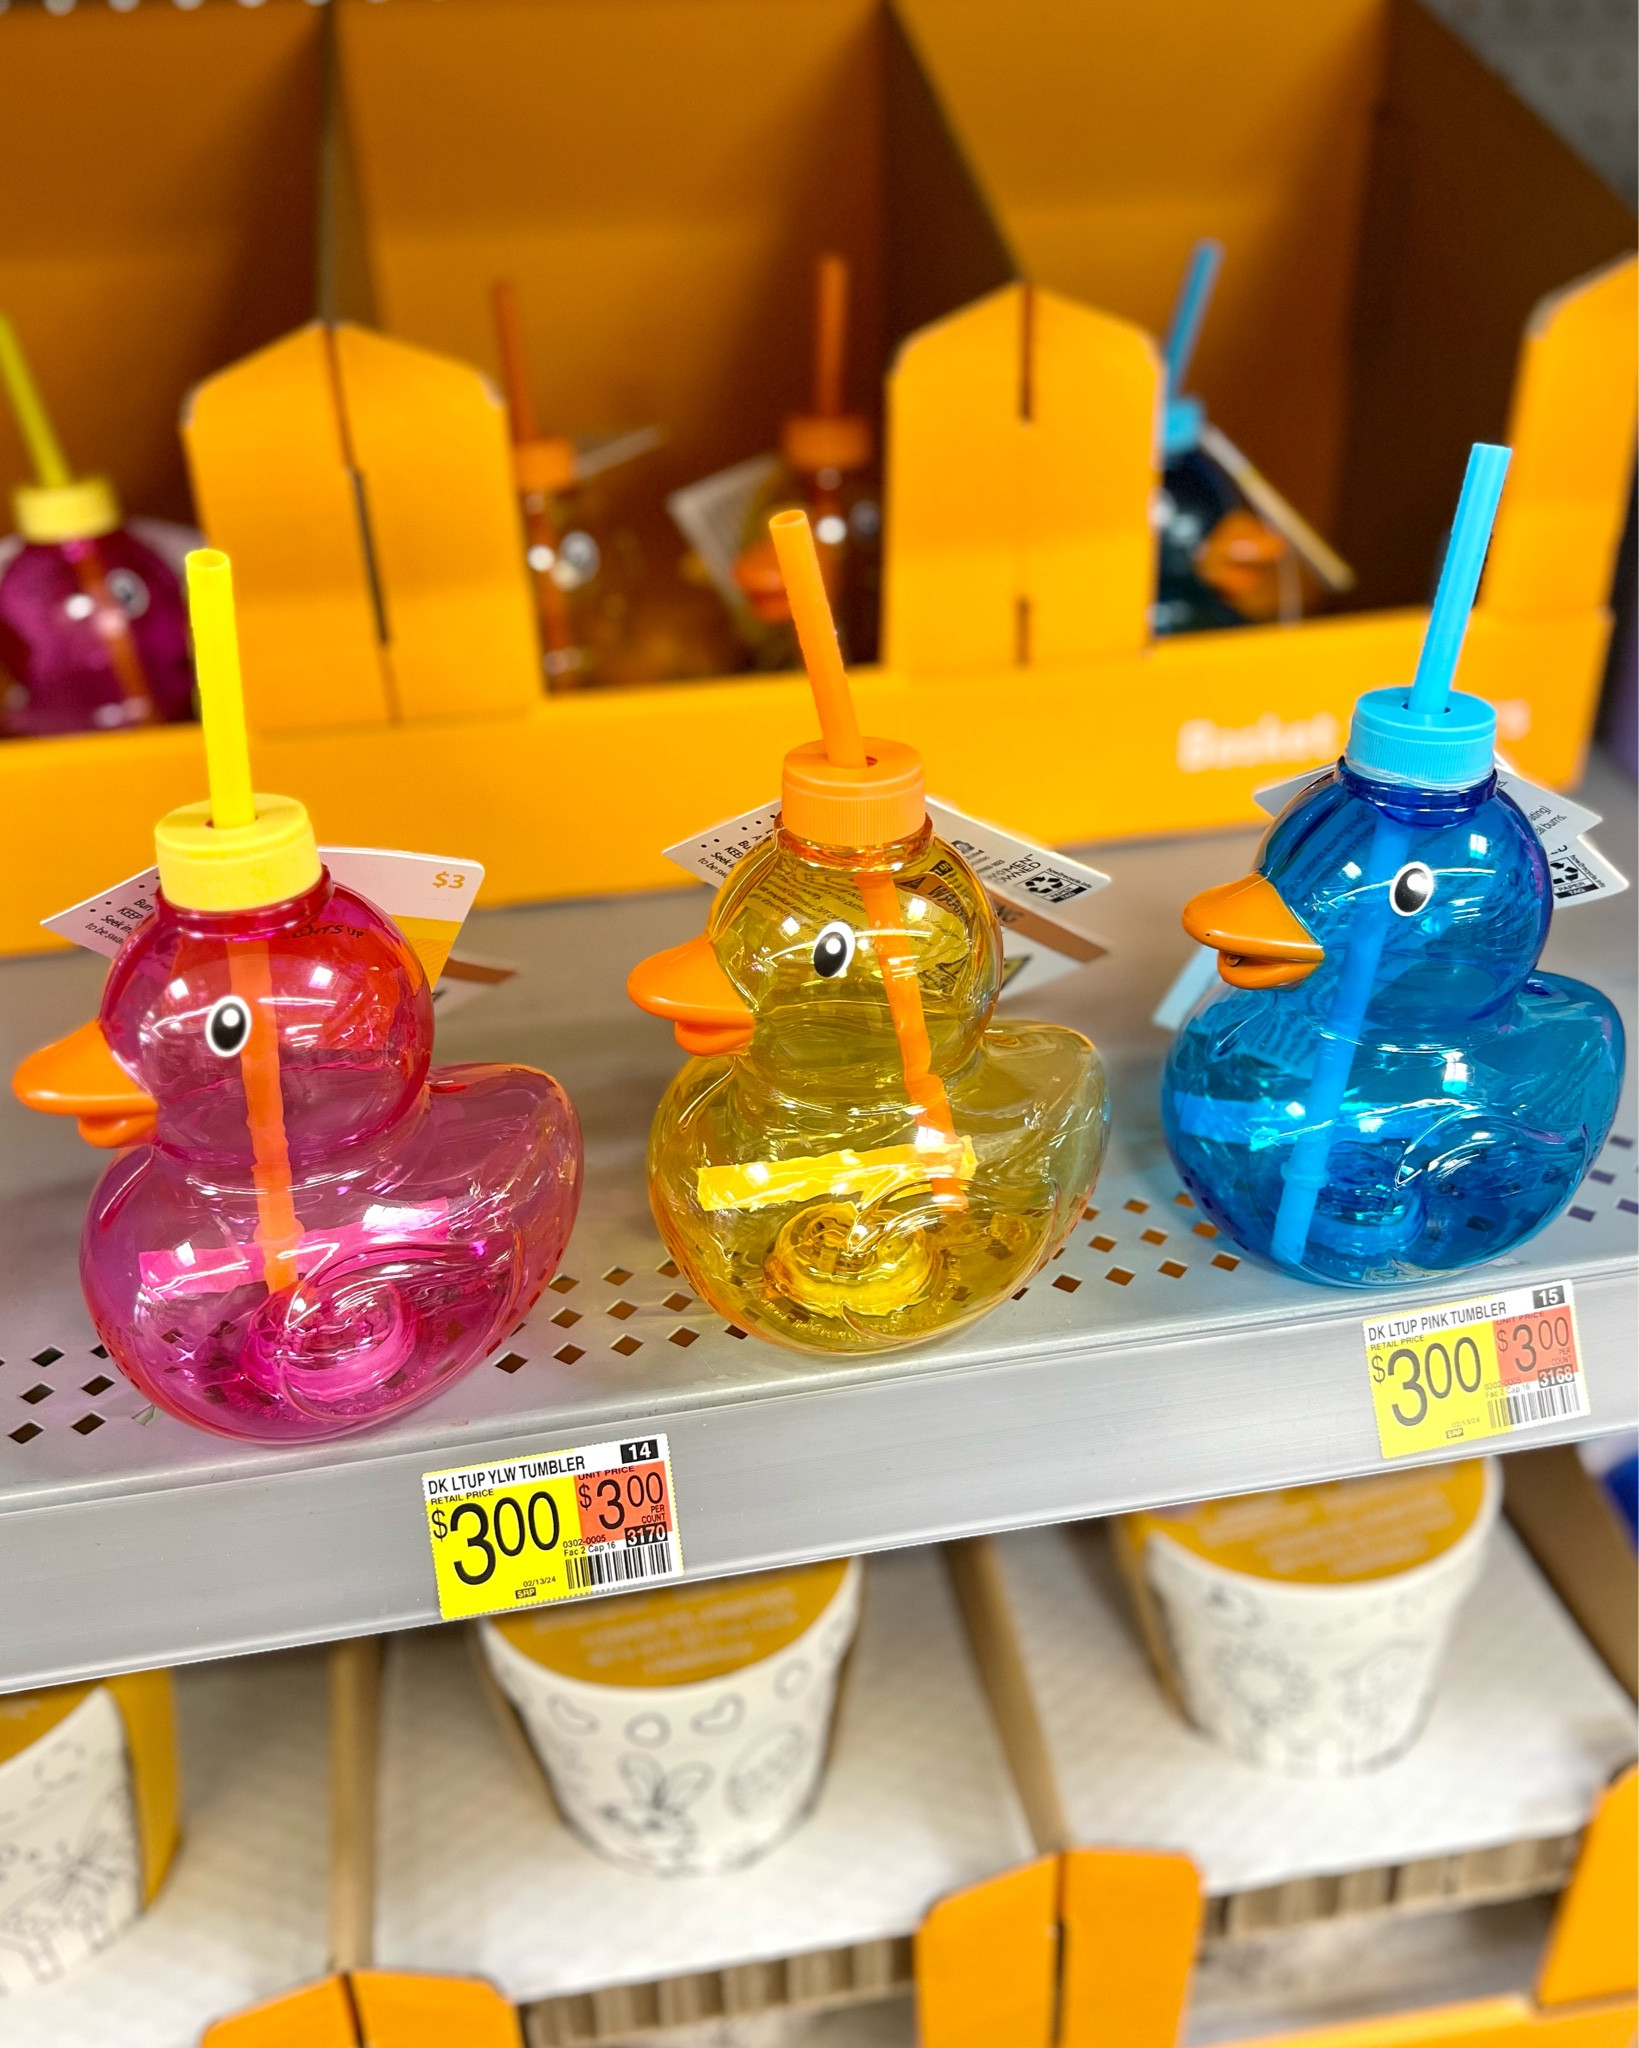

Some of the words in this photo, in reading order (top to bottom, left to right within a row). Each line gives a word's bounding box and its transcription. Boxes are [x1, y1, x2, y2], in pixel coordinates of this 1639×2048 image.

[711, 851, 731, 866] Seek
[432, 870, 466, 889] $3
[117, 906, 144, 920] KEEP
[100, 914, 125, 928] Seek
[84, 922, 98, 931] to
[94, 926, 109, 936] be
[1539, 1288, 1559, 1306] 15
[1368, 1325, 1386, 1341] DK
[1388, 1319, 1418, 1338] LTUP
[1421, 1313, 1449, 1331] PINK
[1450, 1301, 1507, 1324] TUMBLER
[1496, 1316, 1517, 1326] UNIT
[1518, 1311, 1545, 1321] PRICE
[1370, 1340, 1399, 1352] RETAIL
[1400, 1335, 1425, 1345] PRICE
[1539, 1365, 1574, 1387] 3168
[1506, 1386, 1521, 1395] Cap
[628, 1442, 652, 1460] 14
[428, 1478, 448, 1495] DK
[452, 1472, 486, 1491] LTUP
[488, 1466, 517, 1485] YLW
[519, 1456, 586, 1479] TUMBLER
[577, 1470, 602, 1480] UNIT
[604, 1465, 636, 1477] PRICE
[430, 1493, 464, 1506] RETAIL
[466, 1488, 495, 1500] PRICE
[650, 1504, 665, 1513] PER
[641, 1512, 666, 1524] COUNT
[562, 1533, 607, 1548] 0302-0005
[626, 1524, 667, 1546] 3170
[563, 1548, 579, 1557] Fac
[588, 1544, 605, 1554] Cap
[606, 1542, 616, 1550] 16
[522, 1575, 557, 1587] 02/13/24
[516, 1588, 536, 1598] SRP
